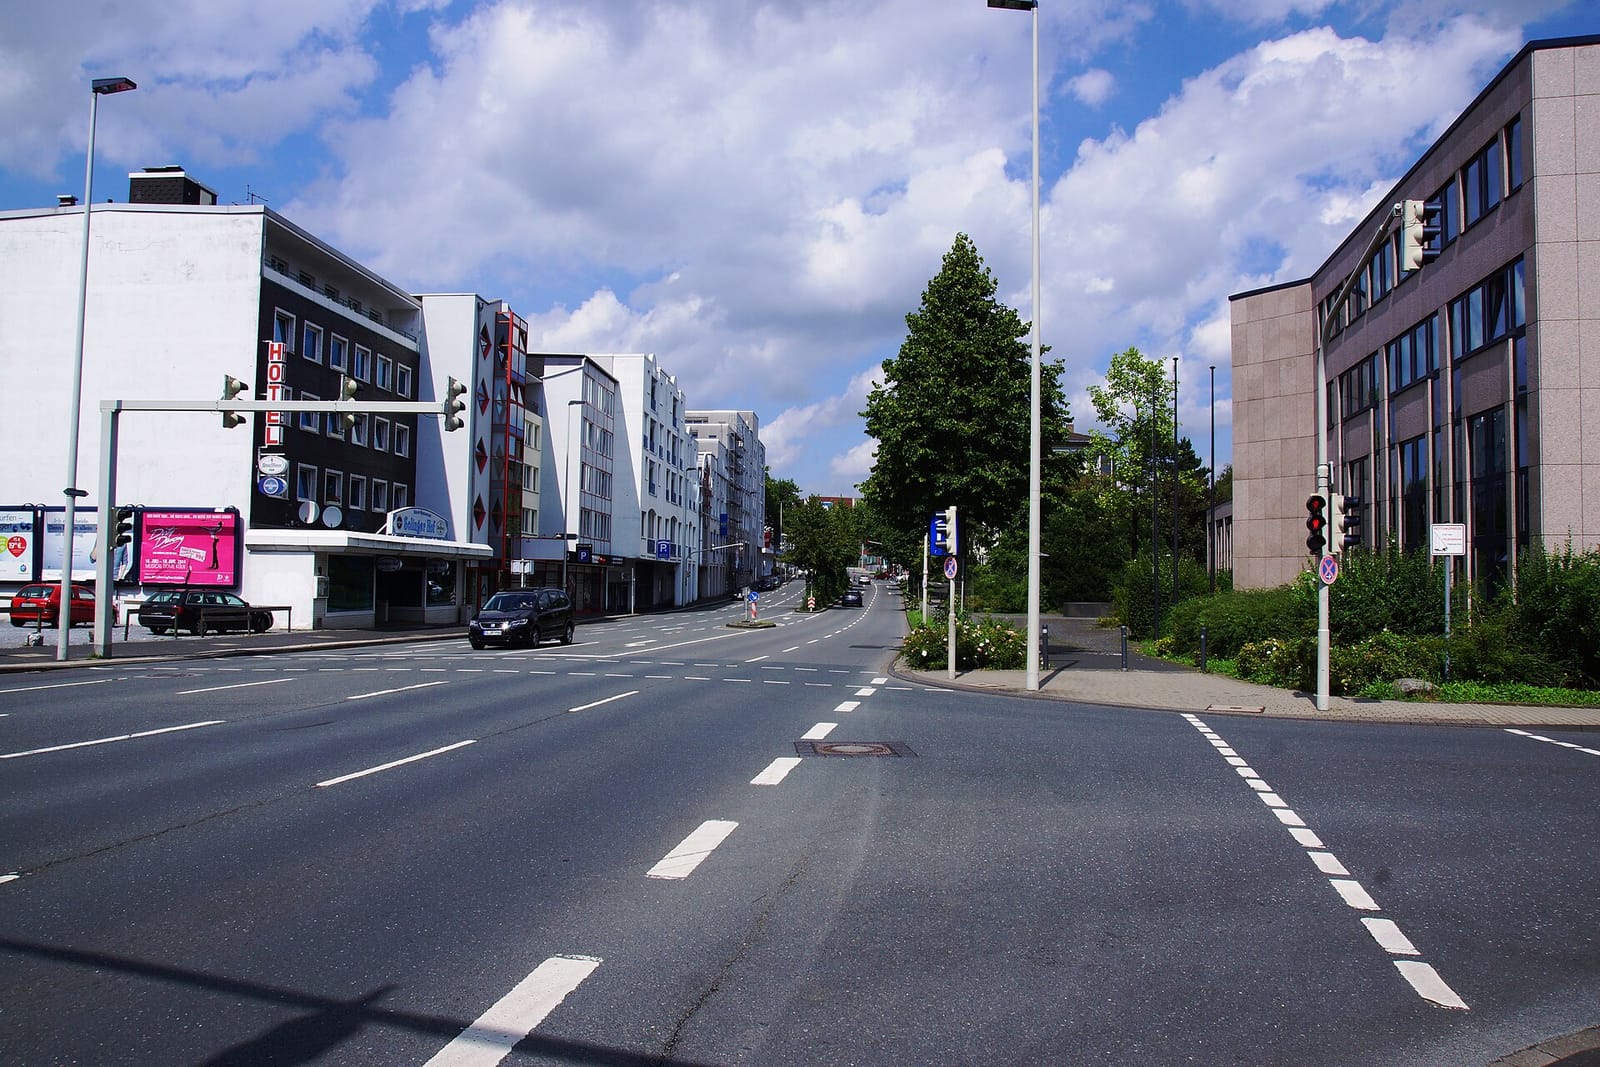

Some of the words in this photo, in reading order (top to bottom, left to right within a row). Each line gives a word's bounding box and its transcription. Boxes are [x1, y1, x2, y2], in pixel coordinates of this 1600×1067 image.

[266, 343, 282, 444] HOTEL
[660, 543, 667, 552] P
[580, 551, 587, 560] P
